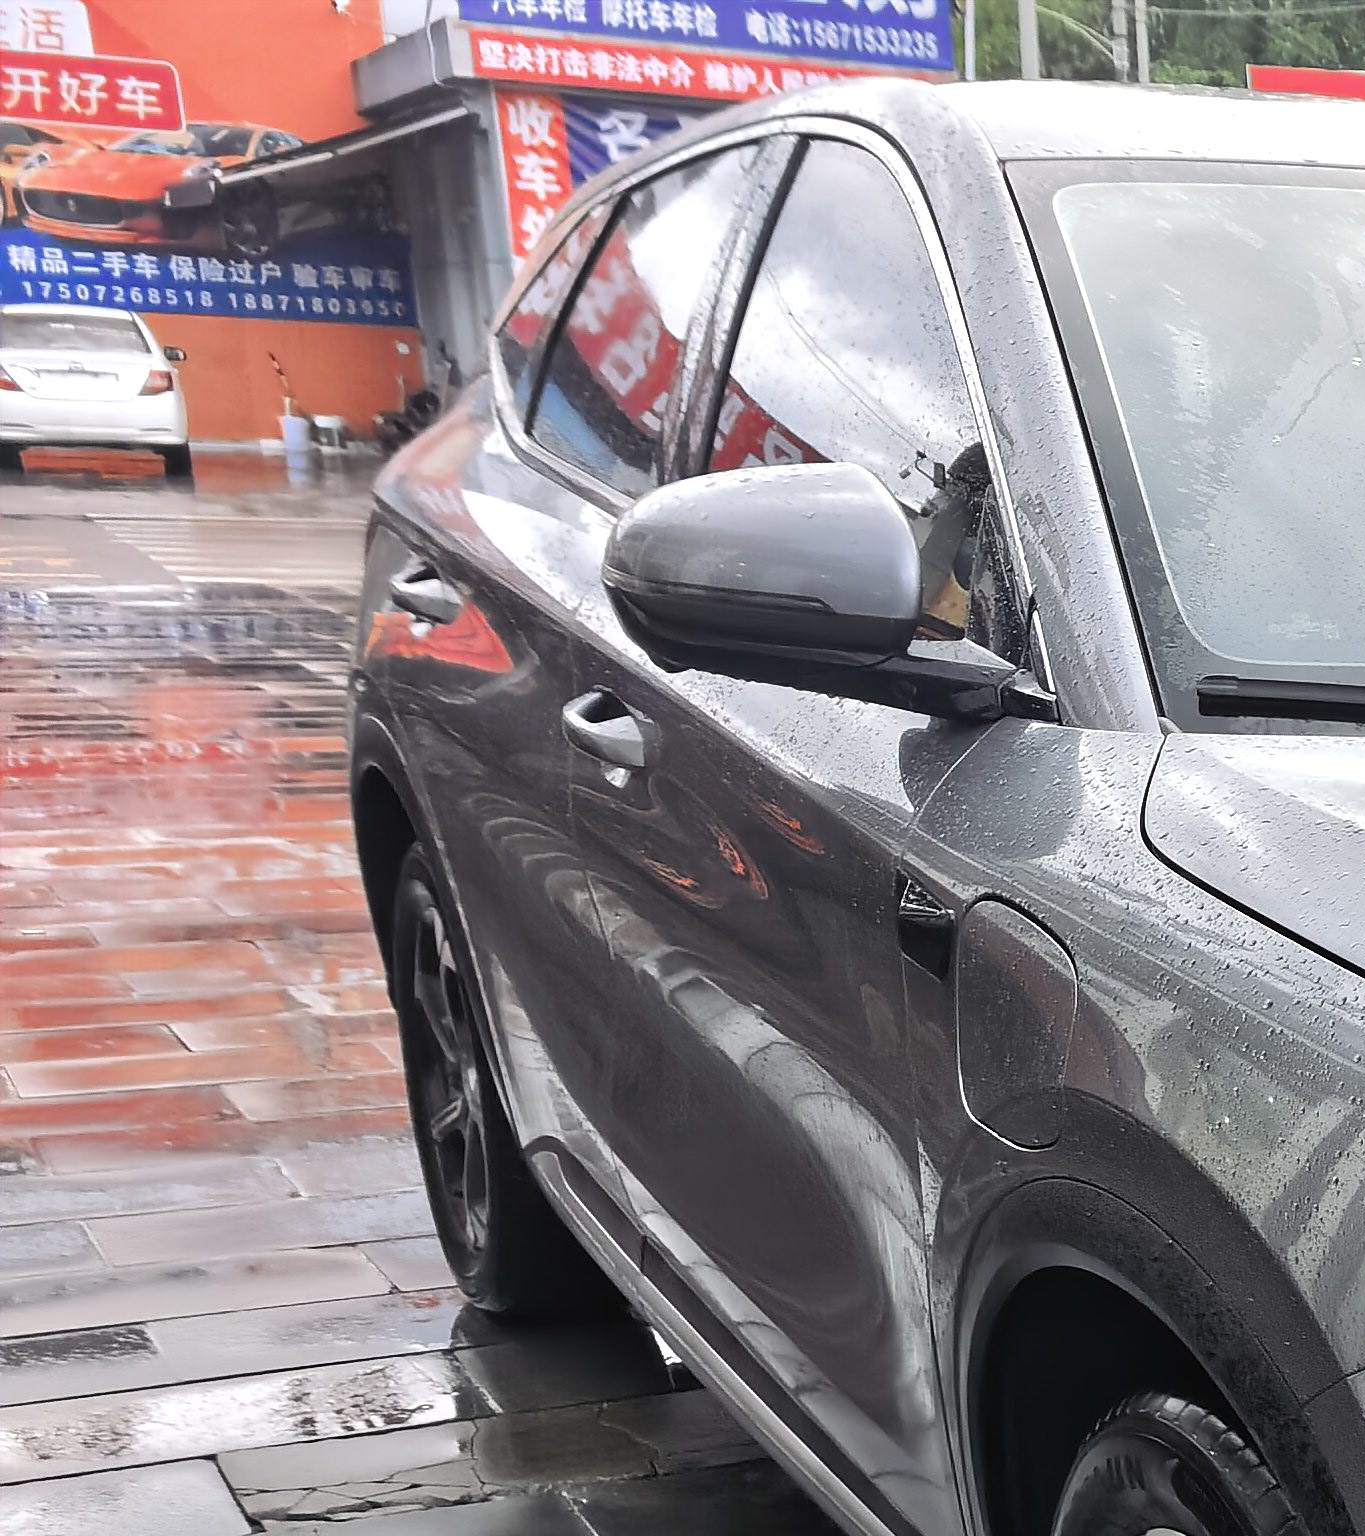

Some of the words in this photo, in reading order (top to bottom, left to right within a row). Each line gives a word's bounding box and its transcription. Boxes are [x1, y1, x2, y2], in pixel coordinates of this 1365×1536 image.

[0, 6, 65, 51] 活
[478, 38, 695, 89] 坚决打击非法中介
[0, 66, 164, 121] 开好车
[6, 243, 161, 281] 精品二手车
[168, 254, 282, 286] 保险过户
[22, 280, 213, 308] 17507268518
